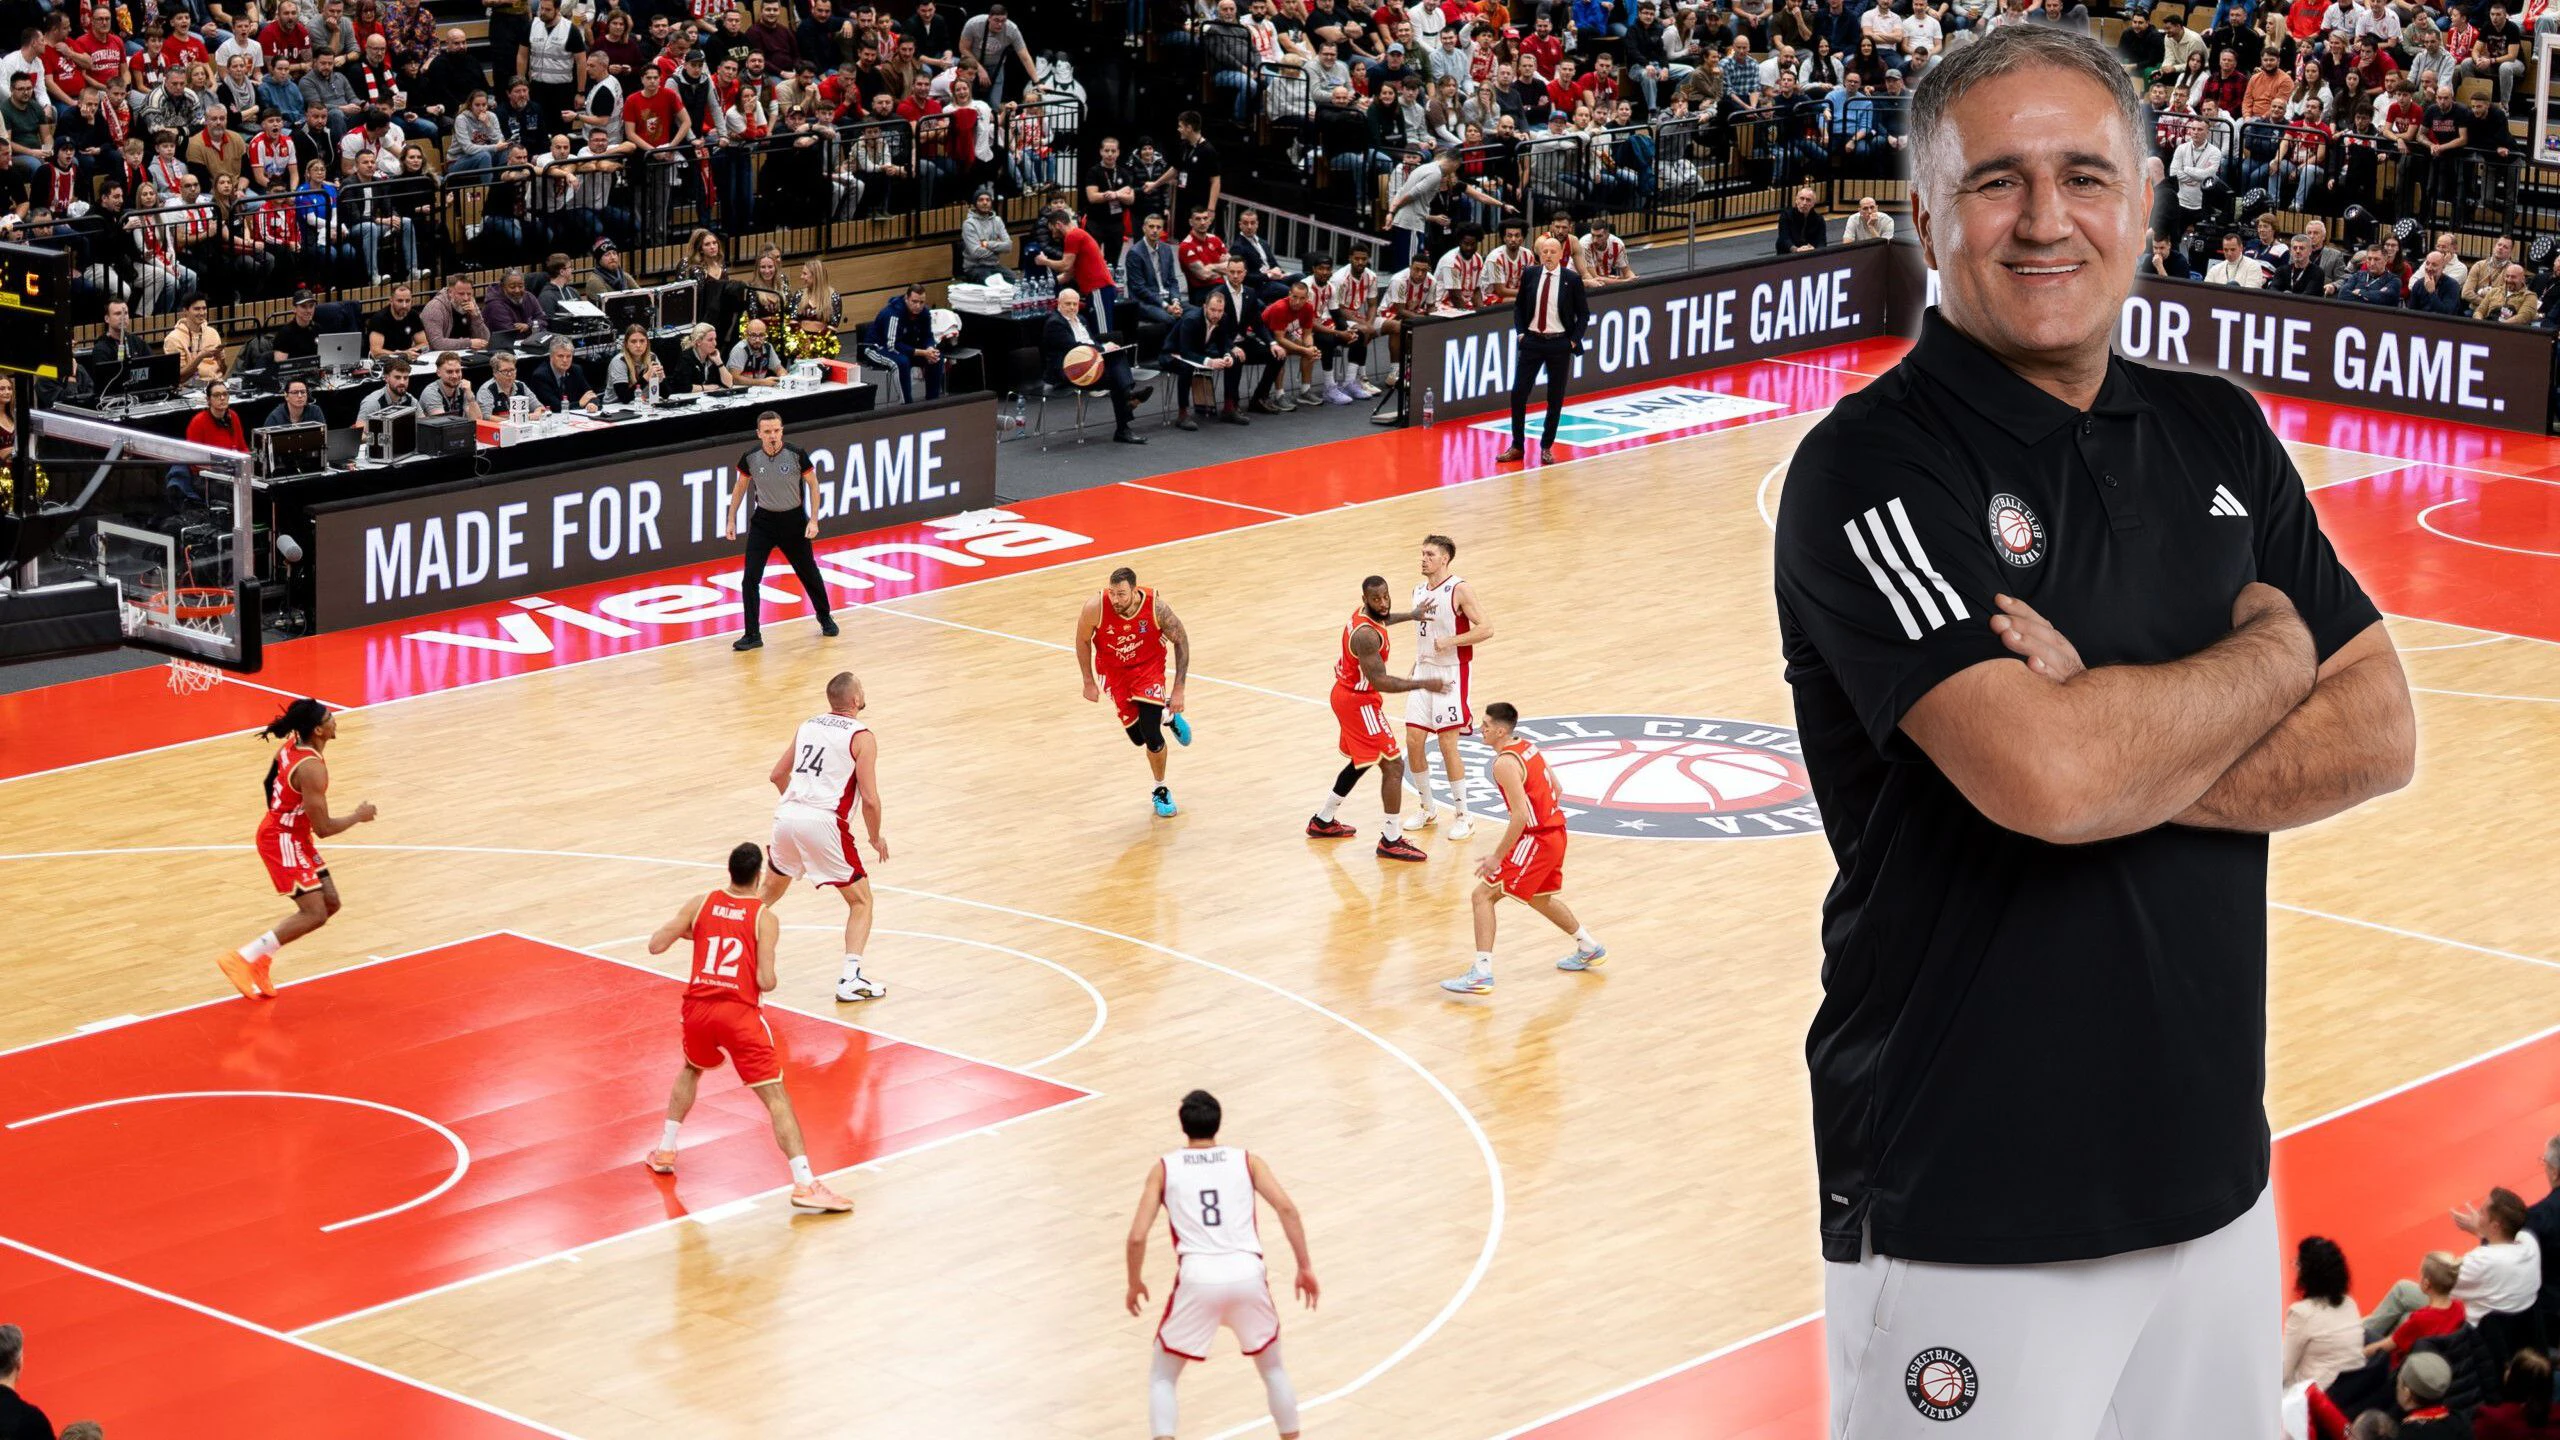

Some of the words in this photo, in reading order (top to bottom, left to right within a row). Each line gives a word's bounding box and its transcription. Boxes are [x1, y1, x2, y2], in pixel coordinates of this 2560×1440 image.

[1443, 329, 1549, 403] MA
[1665, 289, 1737, 360] THE
[1749, 268, 1861, 345] GAME.
[2119, 300, 2191, 365] OR
[2210, 308, 2313, 383] THE
[2333, 326, 2507, 411] GAME.
[1593, 393, 1725, 418] SAVA
[365, 502, 528, 605] MADE
[553, 480, 662, 570] FOR
[683, 466, 758, 543] TH
[1990, 497, 2023, 536] BASKETBALL
[2024, 511, 2043, 539] CLUB
[2004, 549, 2041, 565] VIENNA
[401, 521, 1095, 655] vienna
[1448, 706, 1458, 722] 3
[795, 744, 826, 777] 24
[701, 936, 744, 978] 12
[1199, 1189, 1221, 1227] 8
[1907, 1349, 1963, 1387] BASKETBALL
[1961, 1366, 1976, 1397] CLUB
[1917, 1399, 1962, 1420] VIENNA
